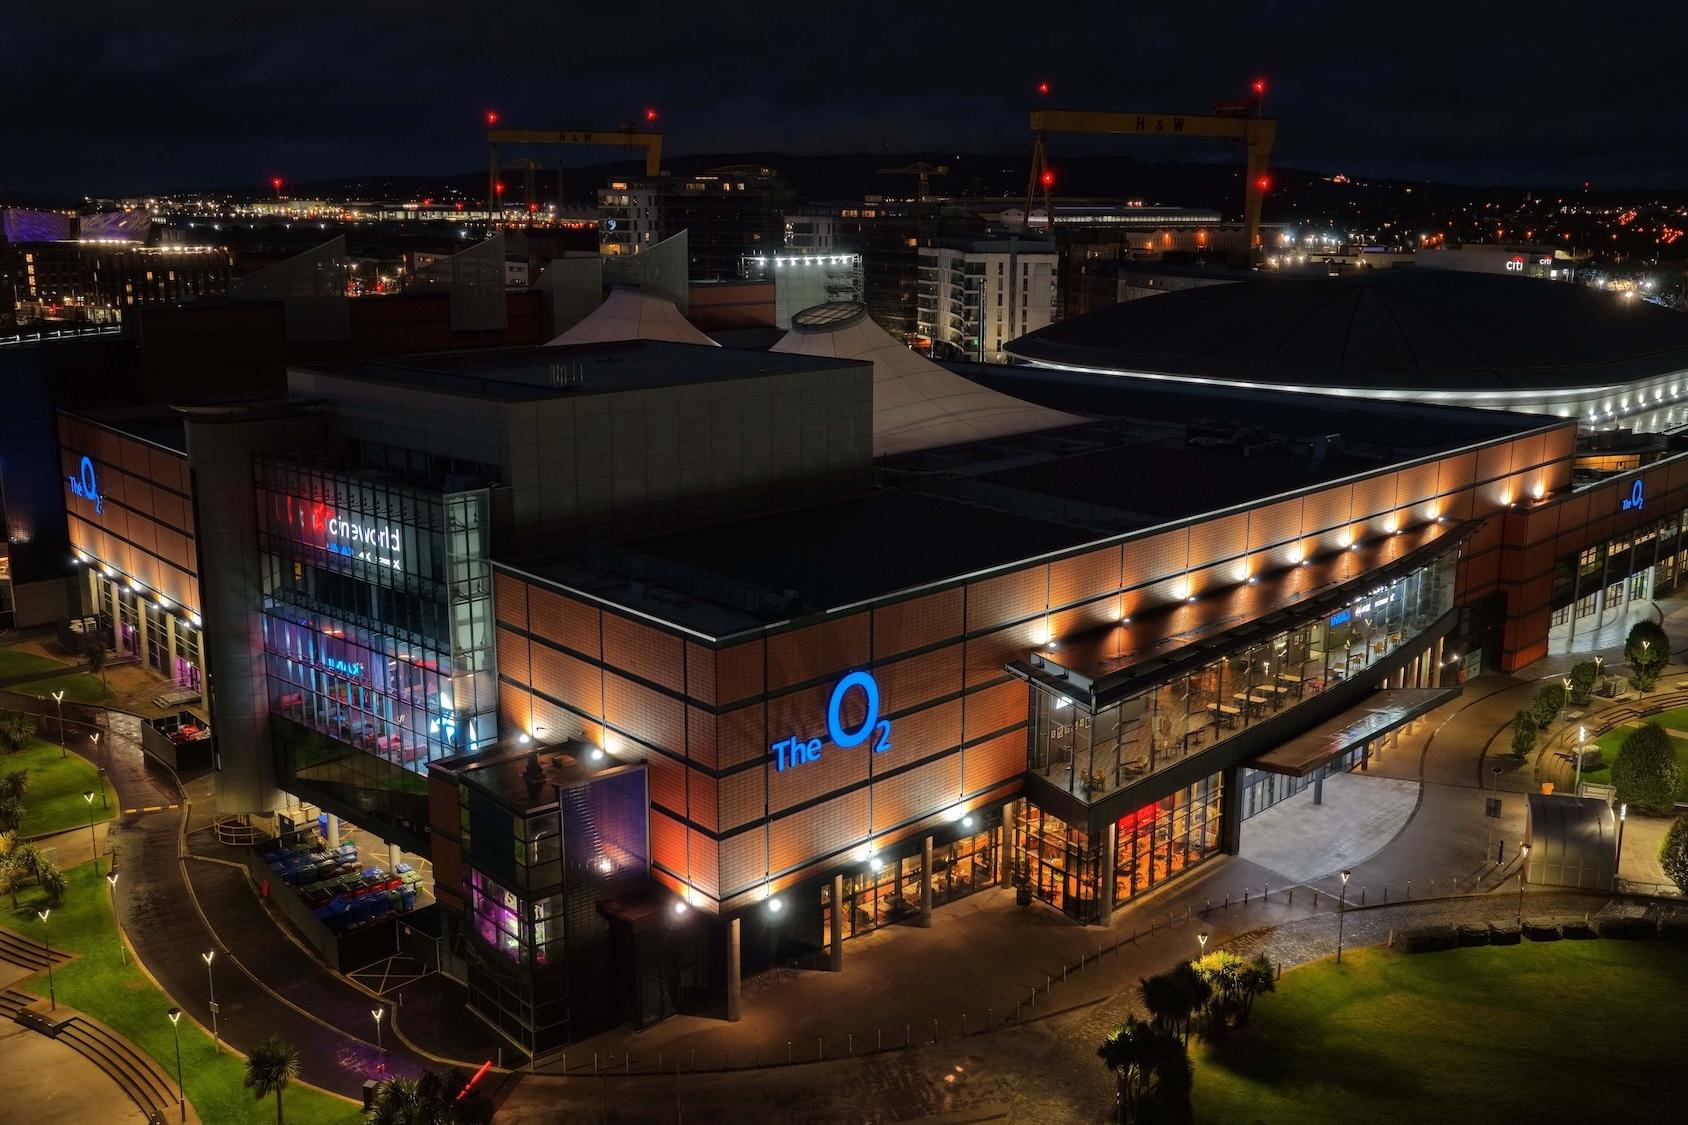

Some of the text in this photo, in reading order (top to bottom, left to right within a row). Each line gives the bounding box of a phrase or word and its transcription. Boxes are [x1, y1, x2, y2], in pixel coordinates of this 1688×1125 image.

[1136, 116, 1185, 132] H & W
[1506, 259, 1524, 271] citi
[328, 515, 401, 552] cineworld
[771, 671, 893, 772] The O2
